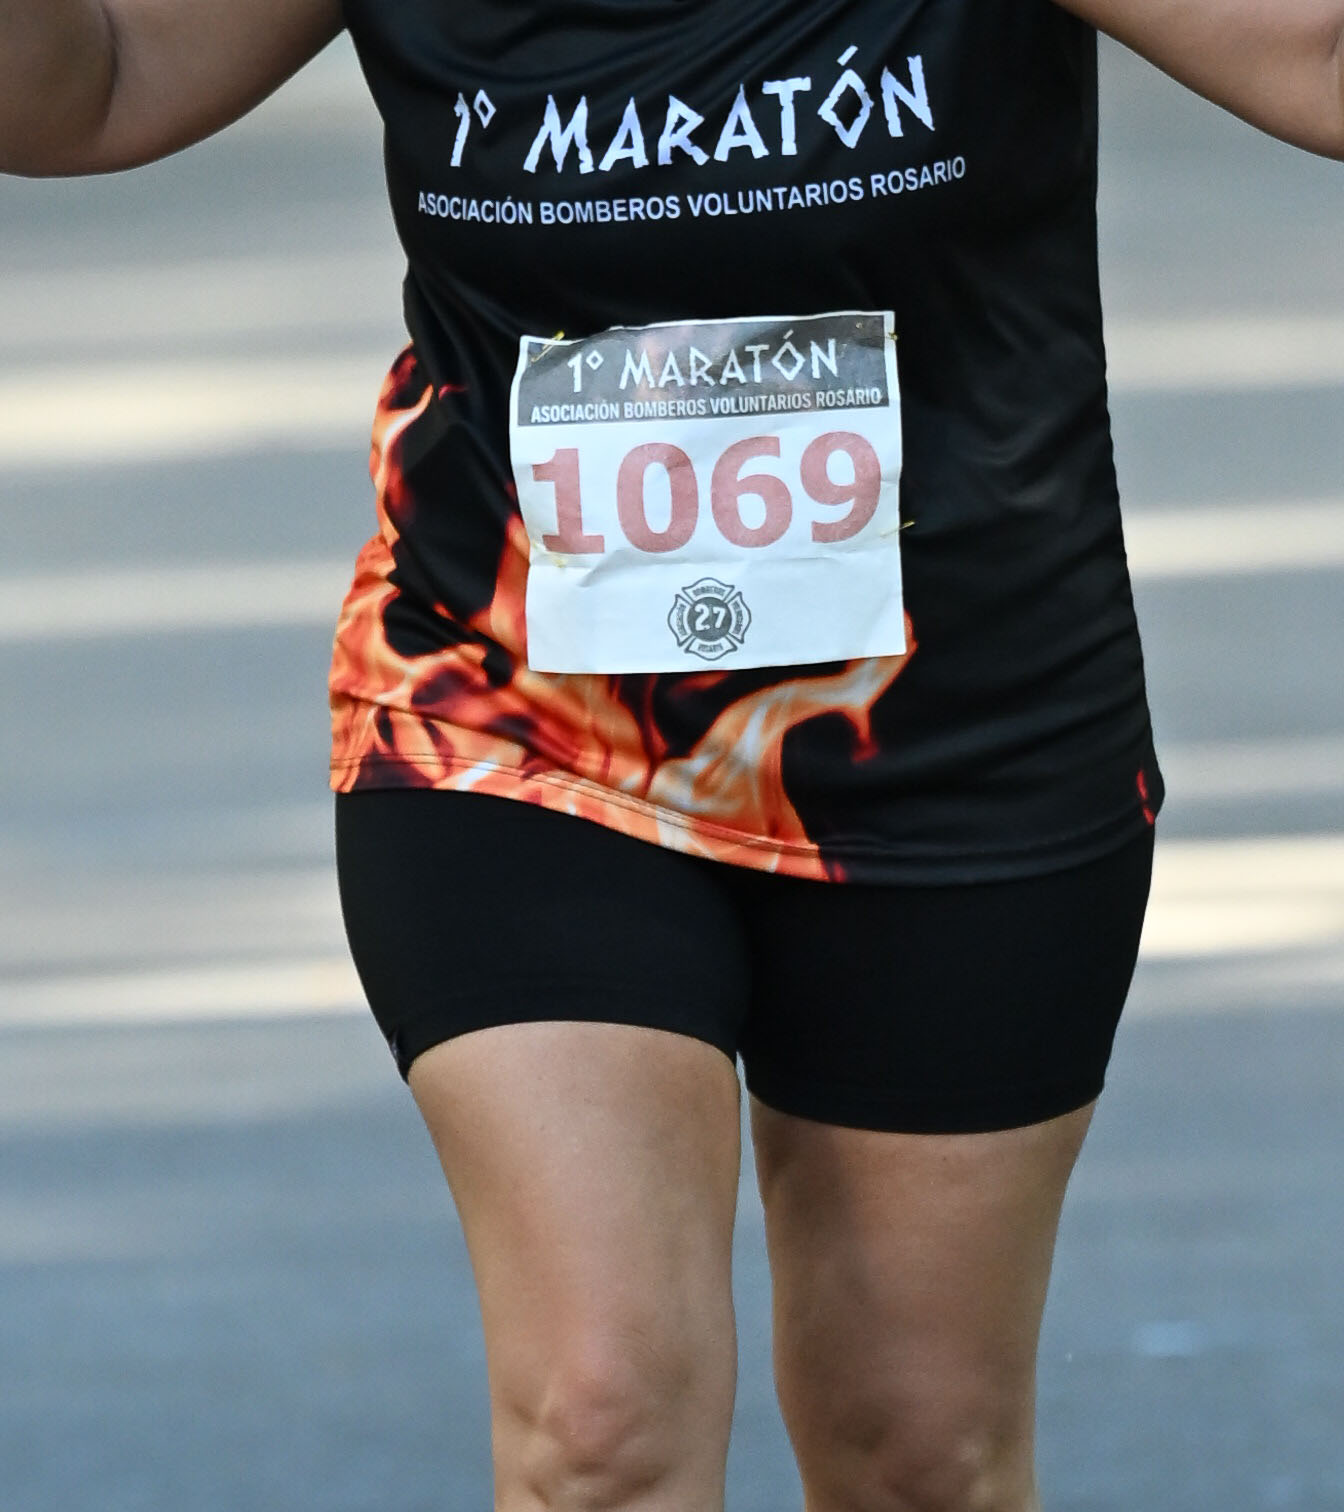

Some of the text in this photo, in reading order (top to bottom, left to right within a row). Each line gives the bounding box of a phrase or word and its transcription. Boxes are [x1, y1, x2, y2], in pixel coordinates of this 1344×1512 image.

[522, 45, 936, 175] MARATÓN
[418, 156, 966, 225] ASOCIACIÓN BOMBEROS VOLUNTARIOS ROSARIO
[619, 329, 839, 390] MARATÓN
[531, 387, 882, 423] ASOCIACIÓN BOMBEROS VOLUNTARIOS ROSARIO
[532, 431, 881, 554] 1069
[694, 603, 726, 631] 27
